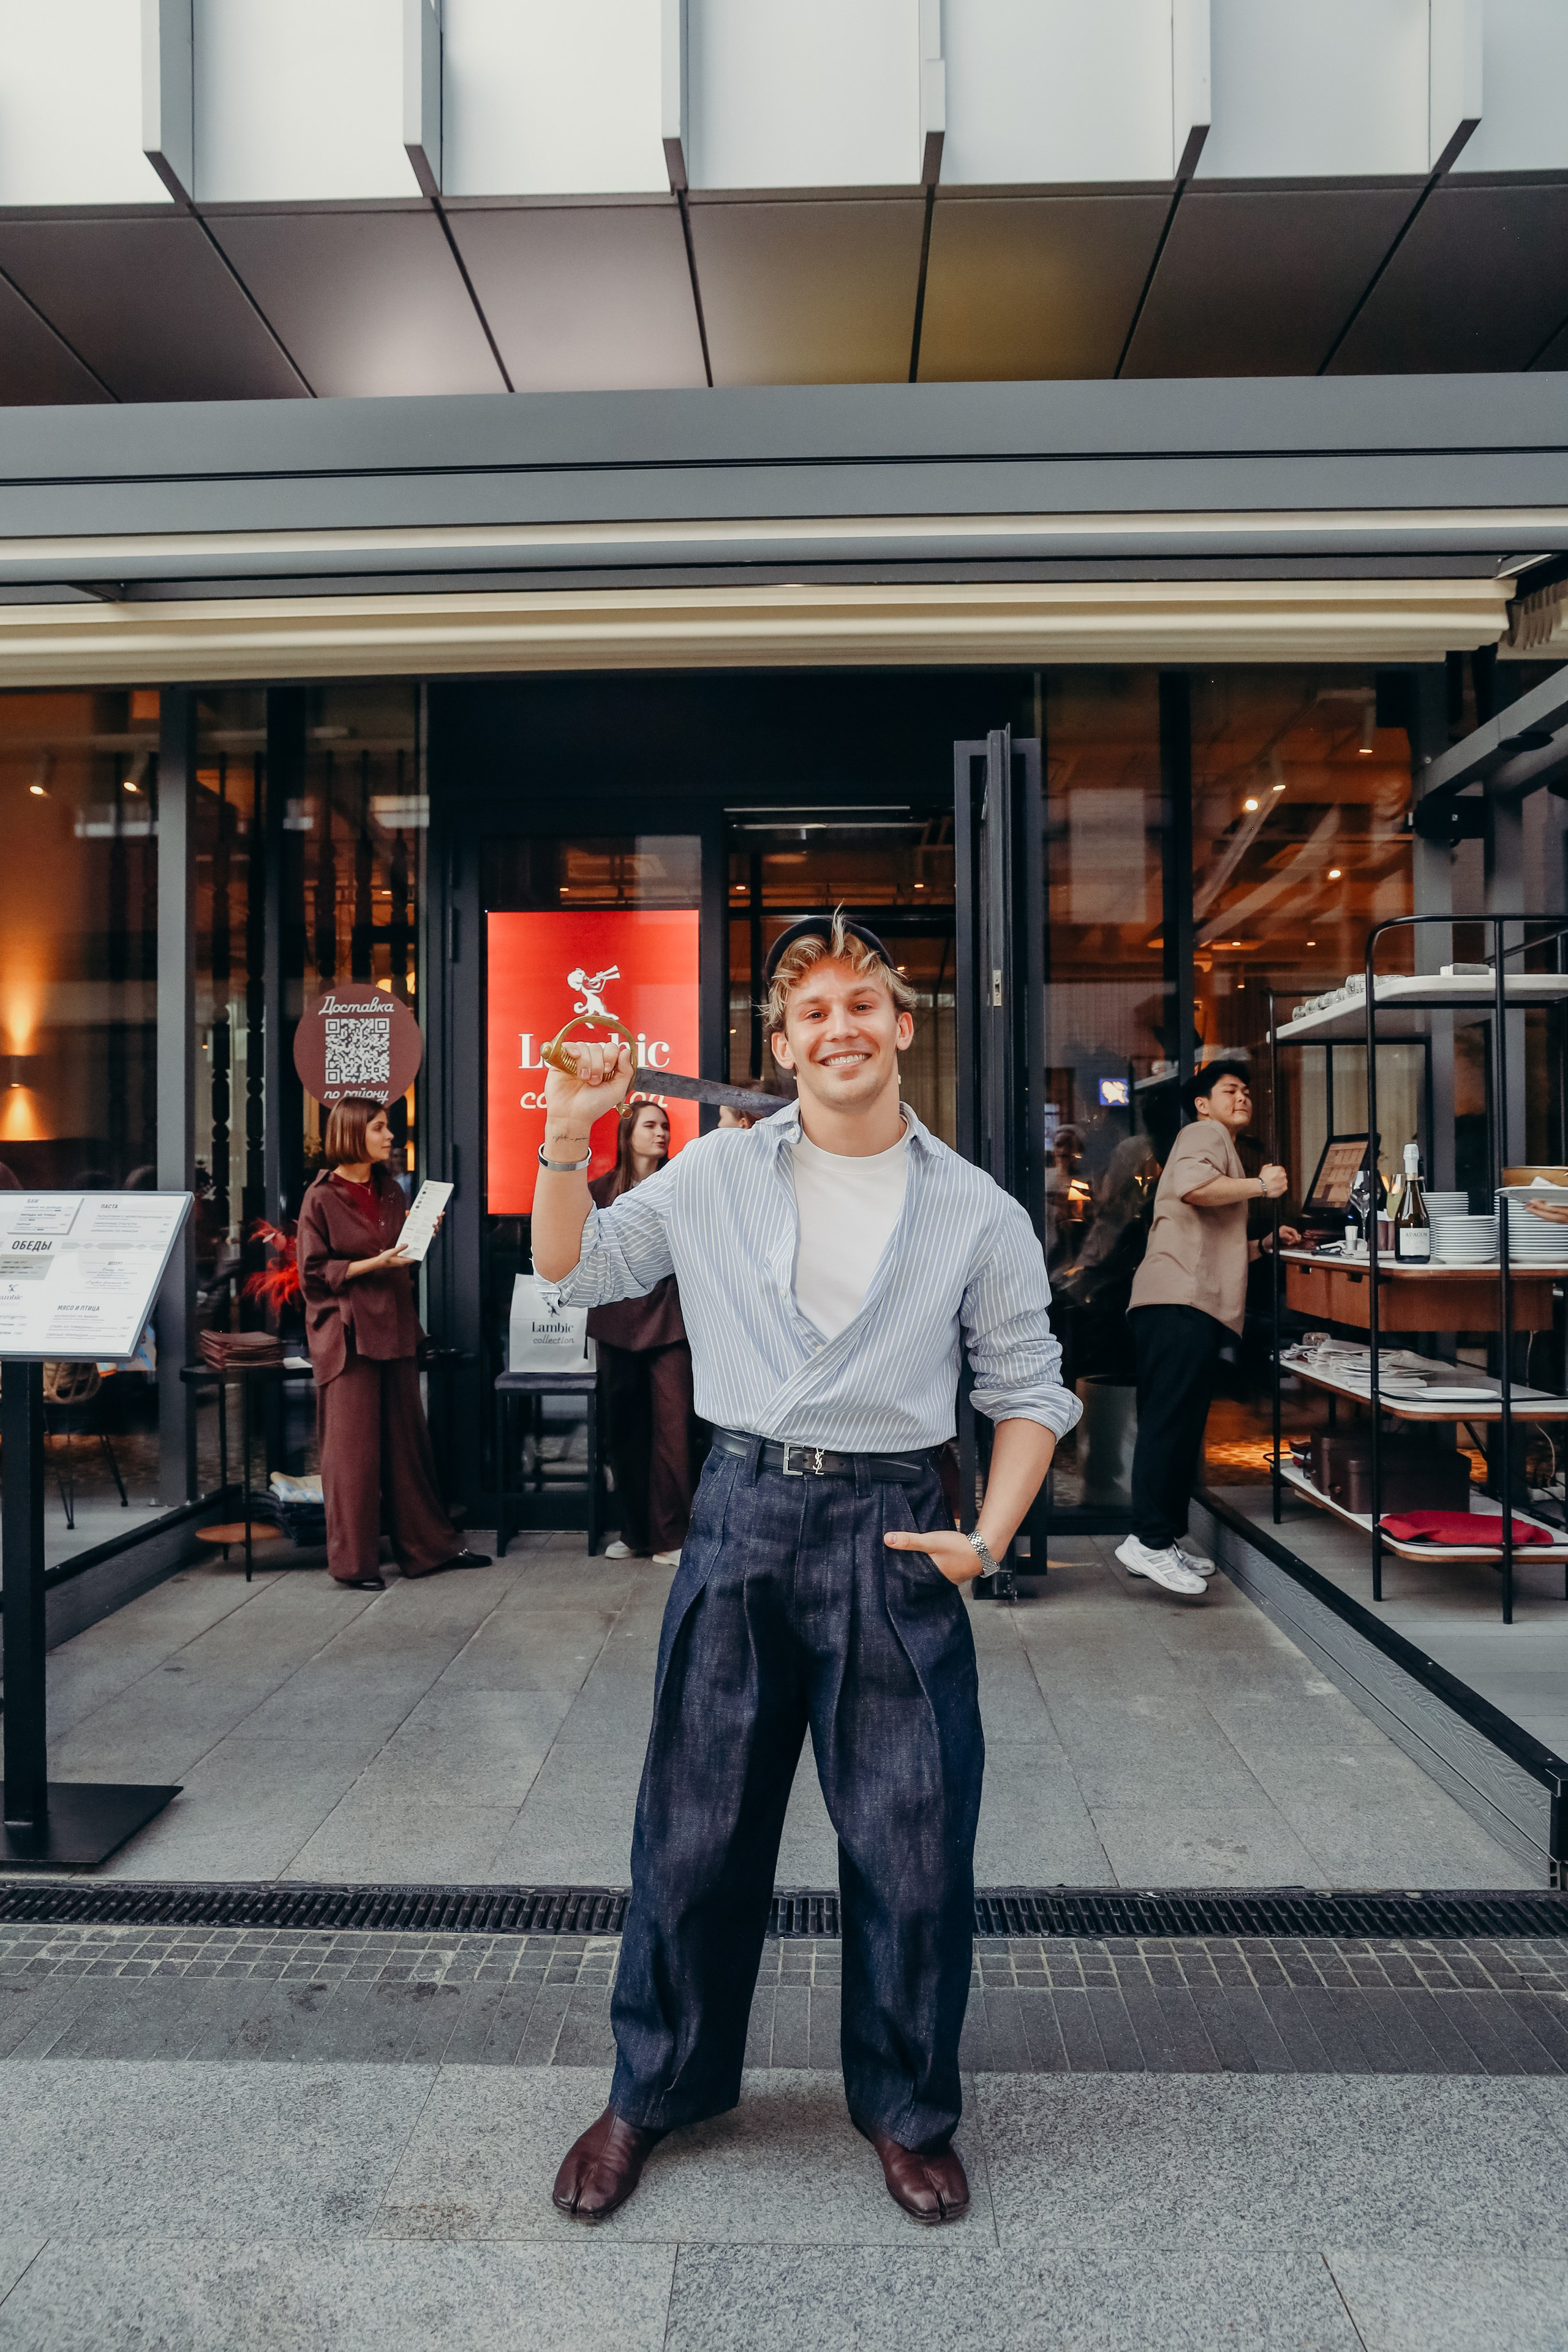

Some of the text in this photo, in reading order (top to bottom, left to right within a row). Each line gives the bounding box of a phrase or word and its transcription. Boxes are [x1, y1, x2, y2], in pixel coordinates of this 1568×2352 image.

[317, 996, 395, 1016] Доставка
[518, 1032, 671, 1069] Lic
[323, 1090, 341, 1099] по
[12, 1240, 53, 1251] ОБЕДЫ
[532, 1321, 574, 1333] Lambic
[533, 1335, 575, 1344] collection
